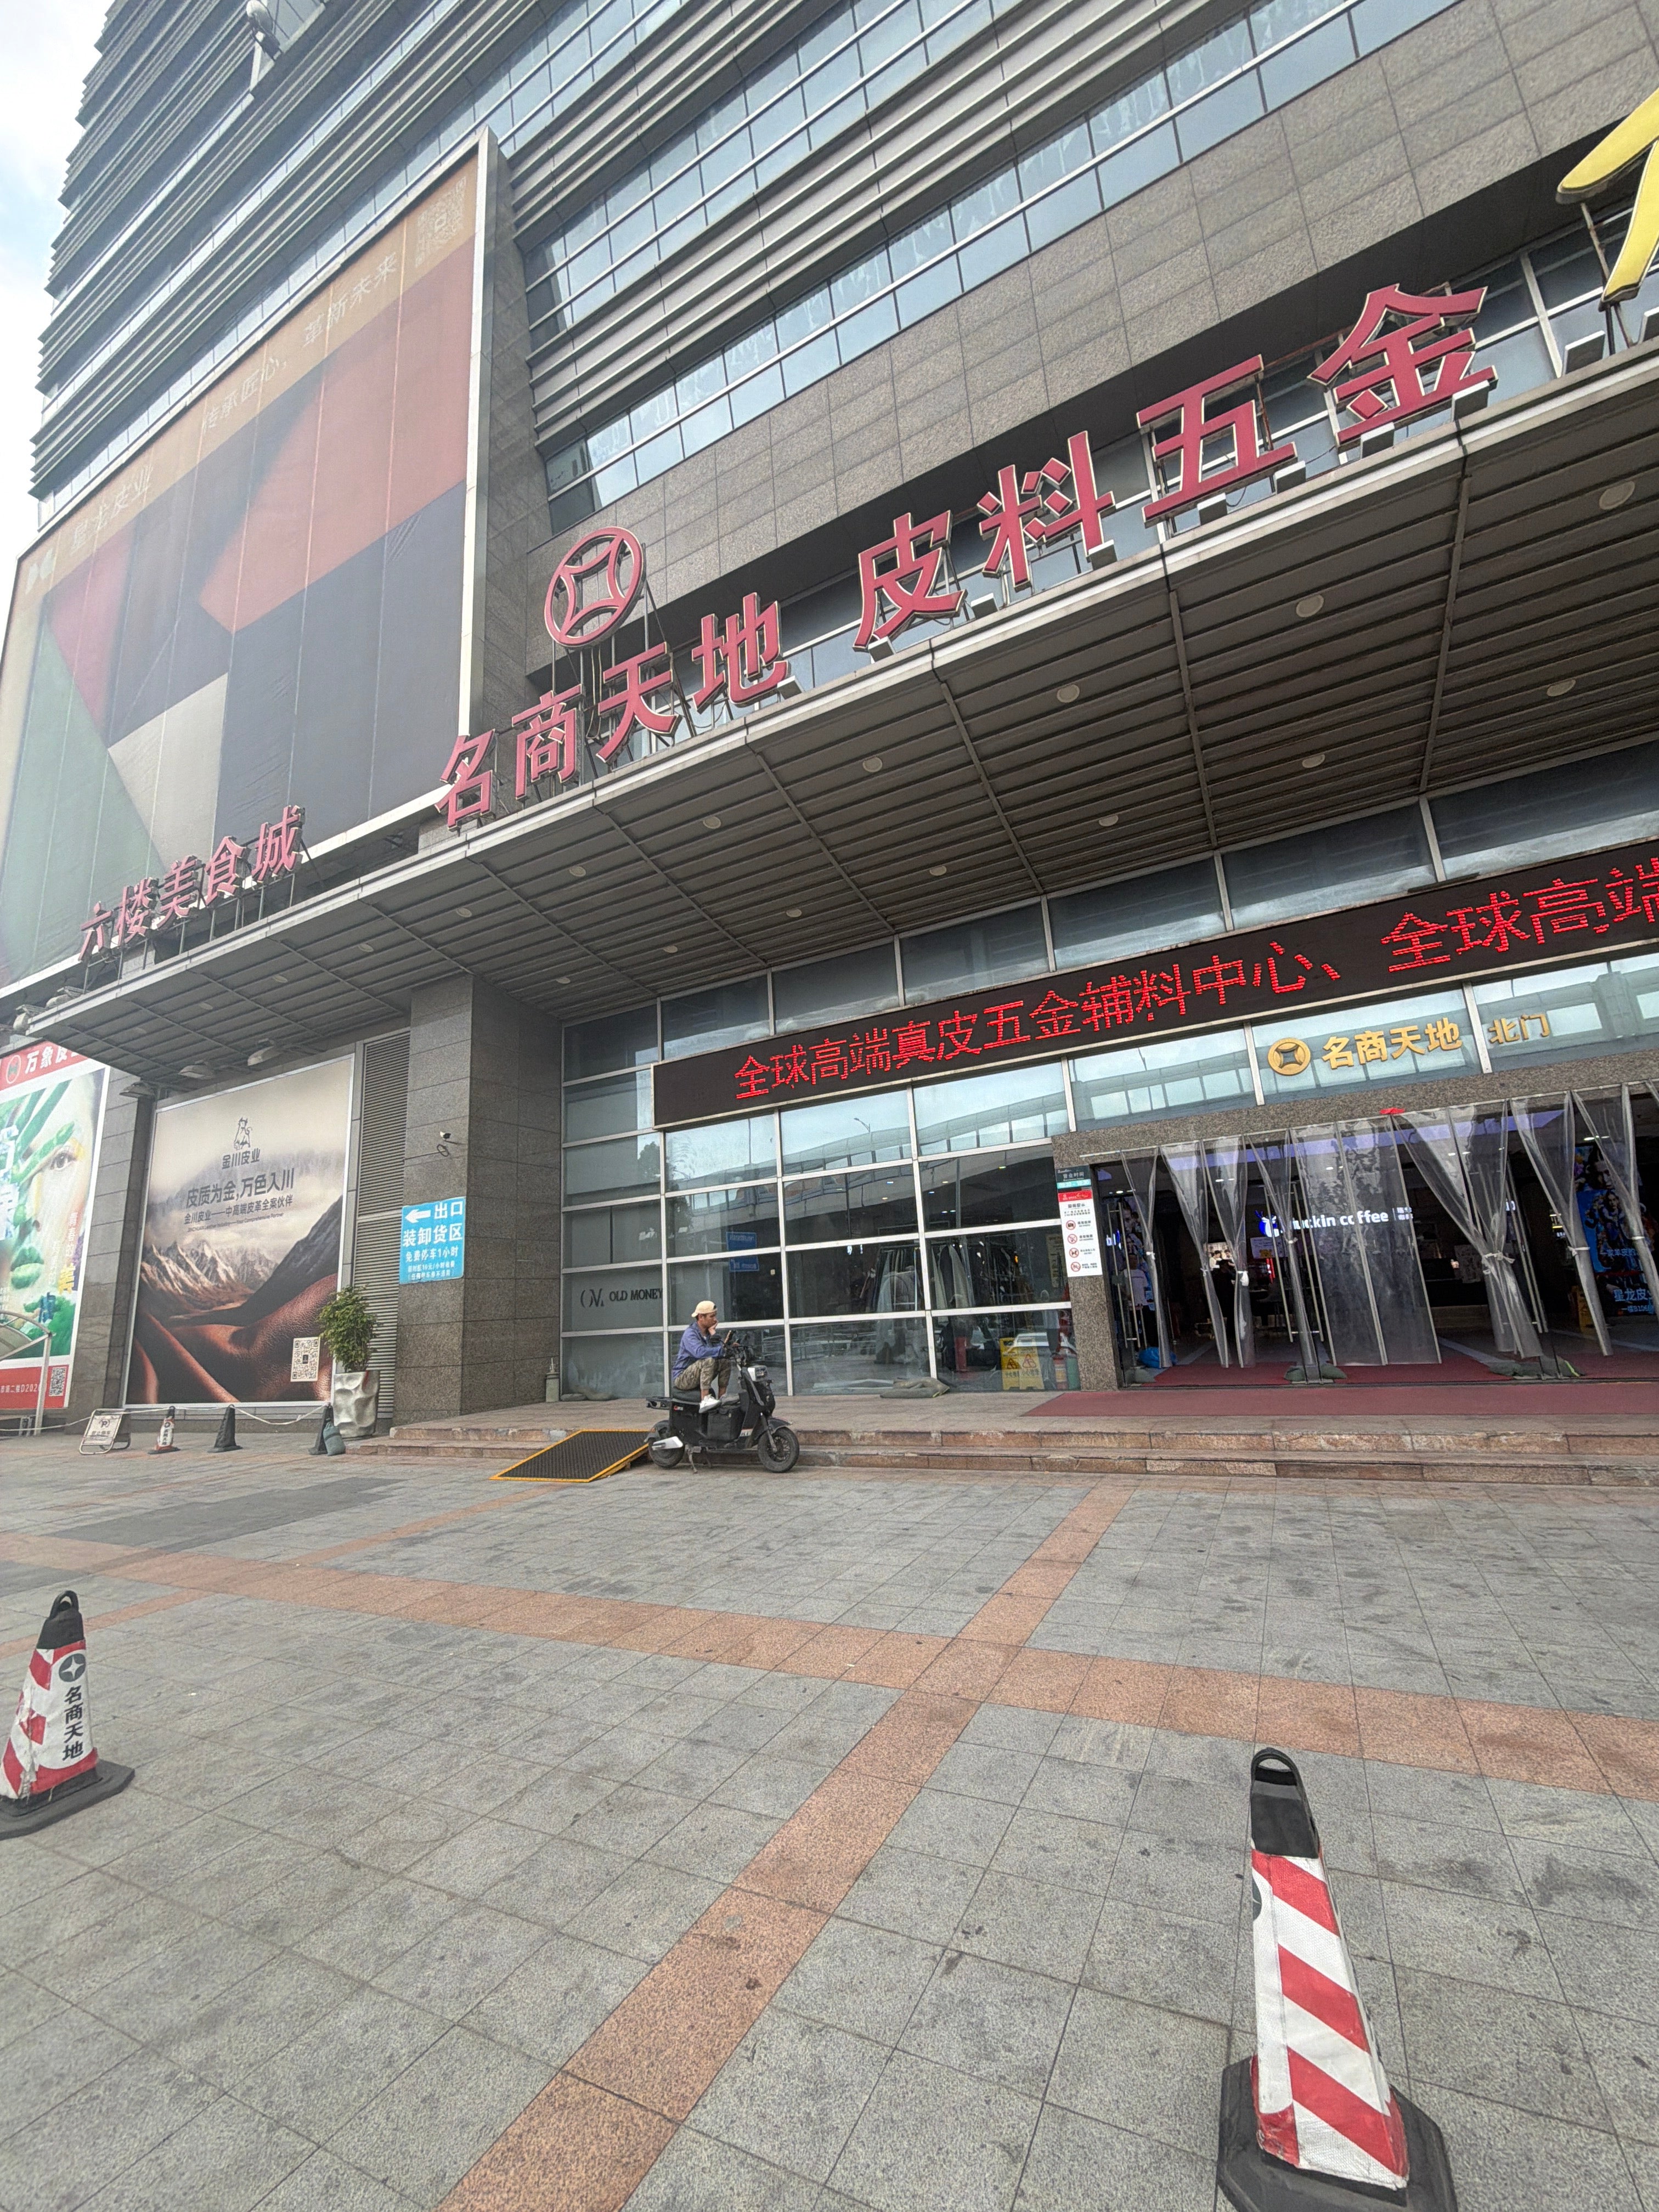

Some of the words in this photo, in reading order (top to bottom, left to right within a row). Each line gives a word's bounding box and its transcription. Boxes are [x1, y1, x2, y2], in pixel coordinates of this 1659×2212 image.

[435, 592, 791, 831] 名商天地
[852, 283, 1498, 652] 皮料五金
[78, 804, 302, 961] 六楼美食城
[1322, 1017, 1464, 1070] 名商天地
[1487, 1013, 1551, 1045] 北门
[25, 1046, 79, 1074] 万象皮
[222, 1148, 261, 1170] 金川皮业
[186, 1167, 295, 1209] 皮质为金，万色入川
[434, 1200, 464, 1220] 出口
[402, 1222, 463, 1248] 装卸货区
[405, 1245, 459, 1263] 免费停车1小时
[610, 1290, 628, 1302] OLD
[630, 1288, 663, 1301] MONEY
[62, 1685, 84, 1762] 名商天地
